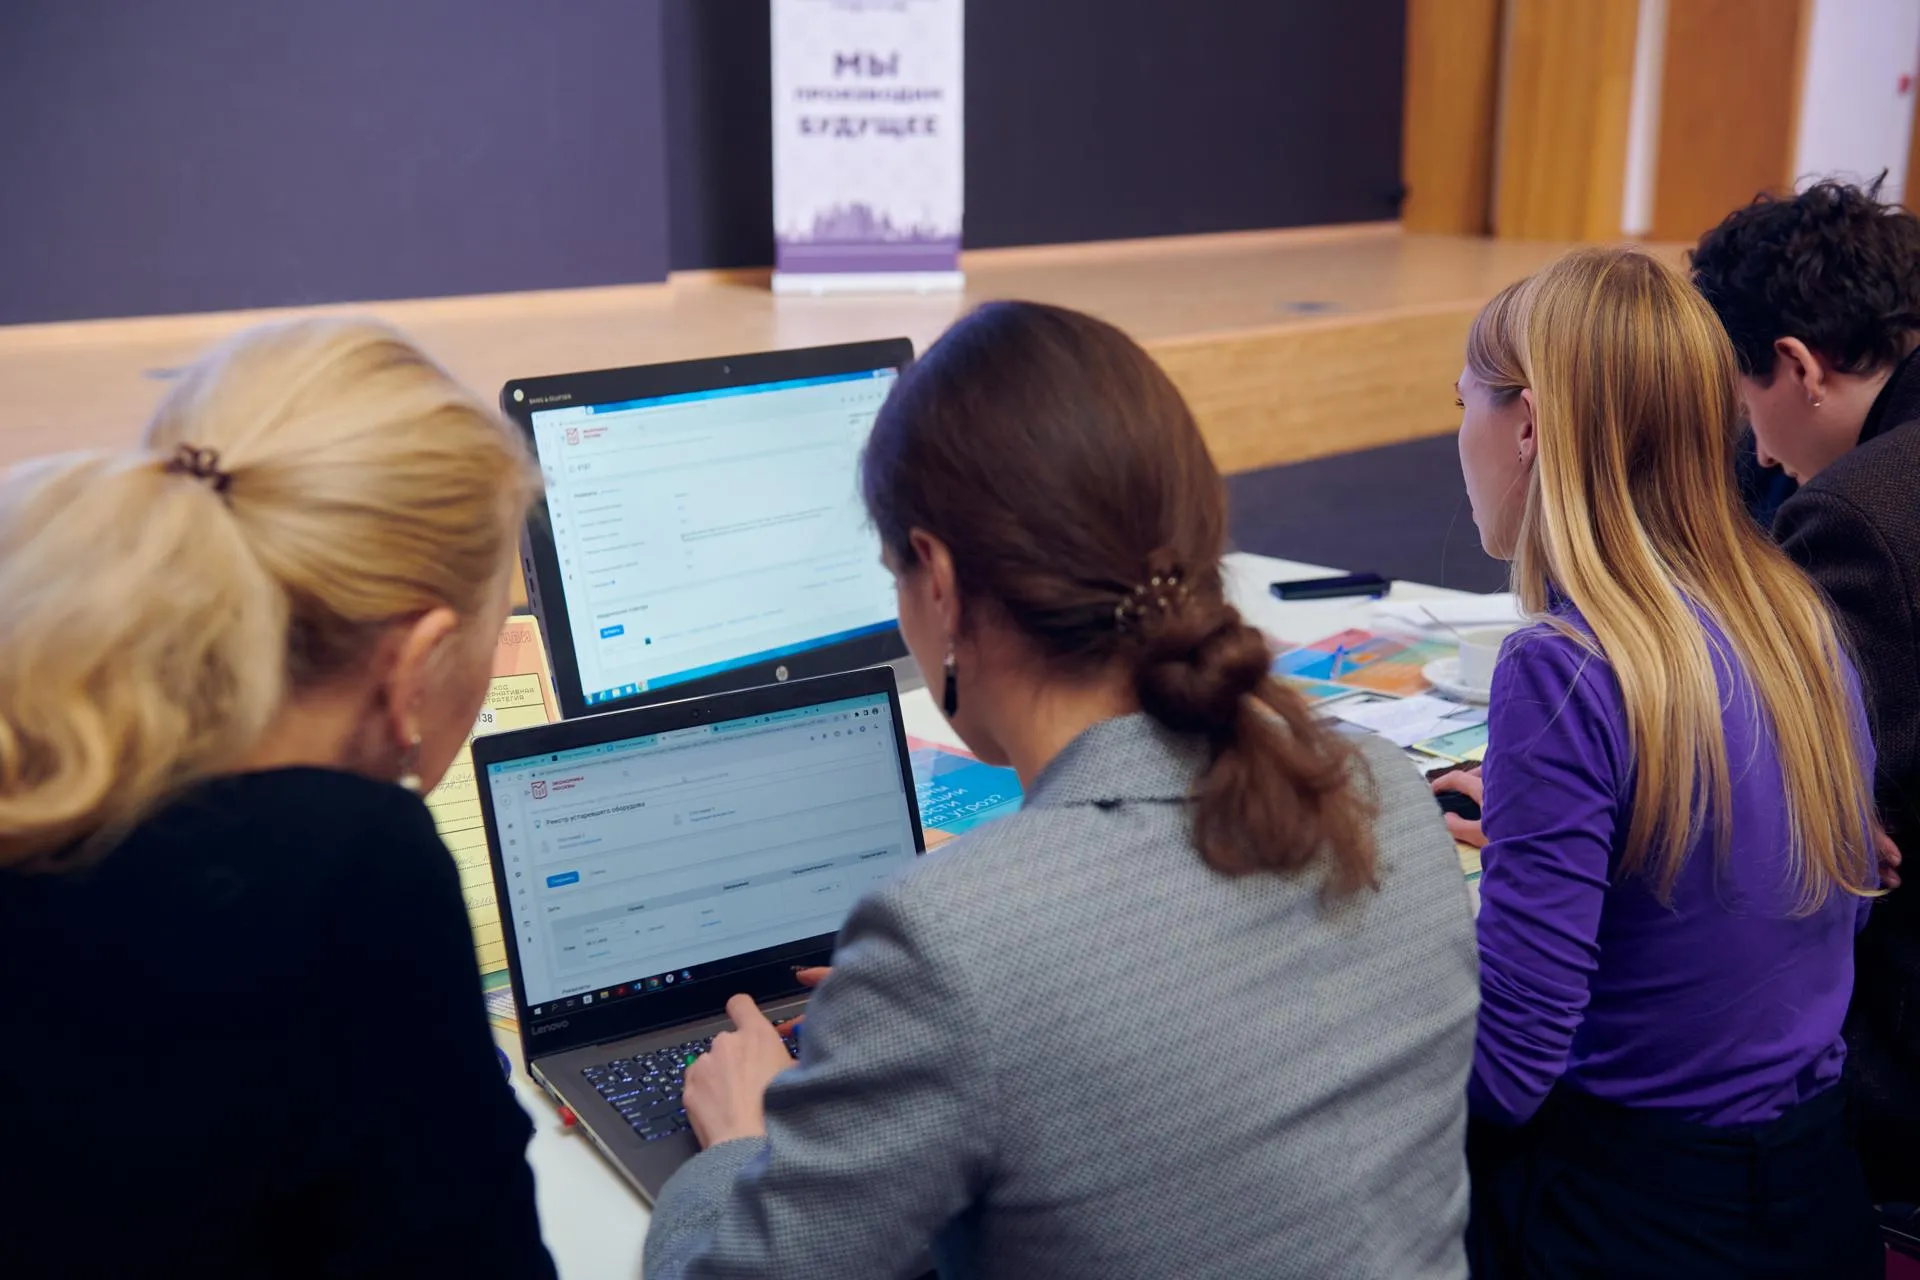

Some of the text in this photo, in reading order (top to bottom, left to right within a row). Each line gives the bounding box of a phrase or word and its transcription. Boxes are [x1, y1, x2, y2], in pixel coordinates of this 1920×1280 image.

[834, 51, 900, 77] МЫ
[798, 115, 938, 139] БУДУЩЕЕ
[531, 1020, 569, 1036] Lenovo
